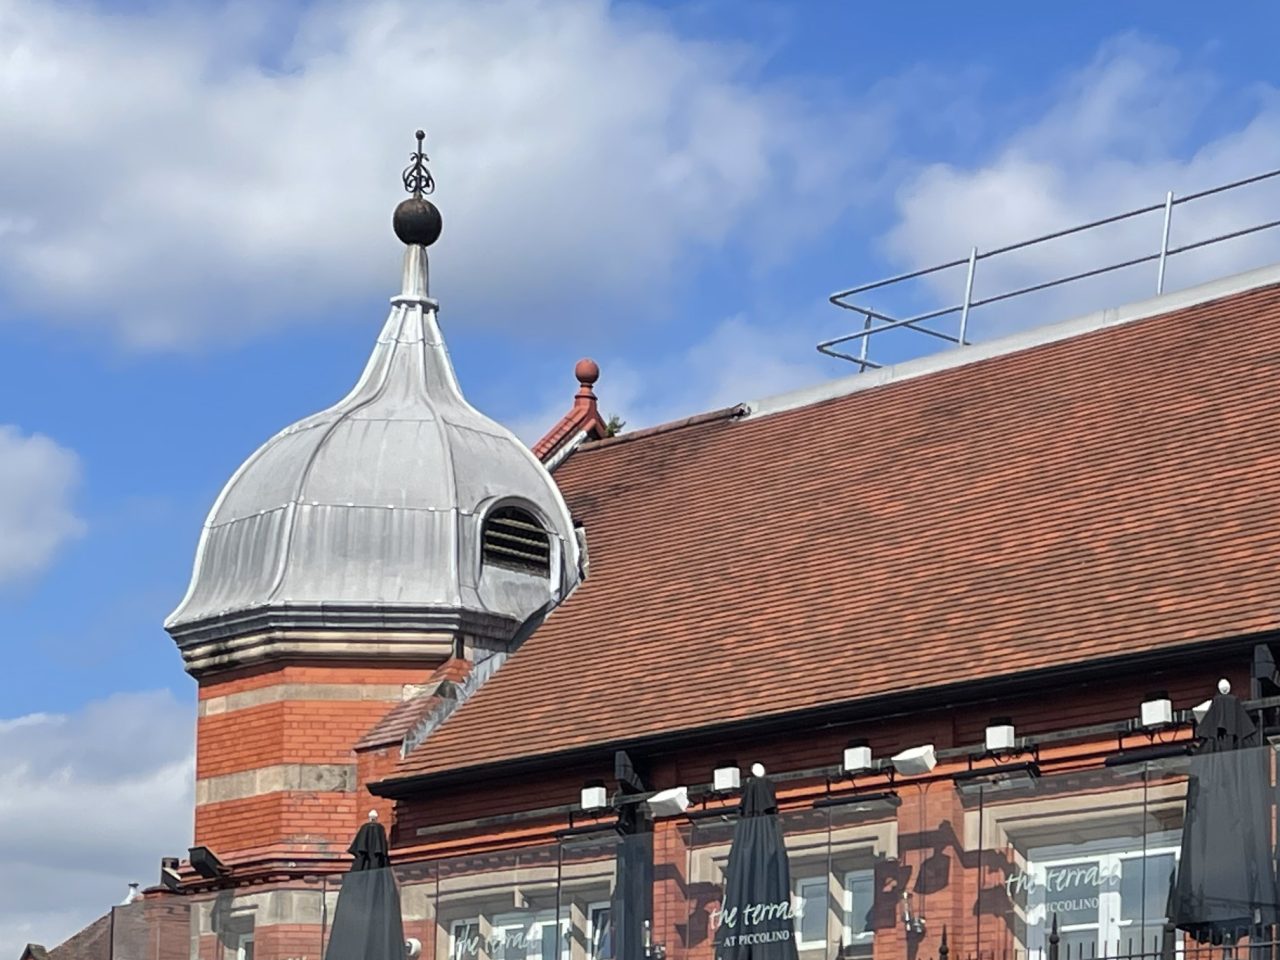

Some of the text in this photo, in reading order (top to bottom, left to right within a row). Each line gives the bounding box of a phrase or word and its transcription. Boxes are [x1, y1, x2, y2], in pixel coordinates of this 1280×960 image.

[1004, 863, 1119, 897] the terrace
[709, 895, 738, 930] the
[723, 930, 790, 947] AT PICCOLINO
